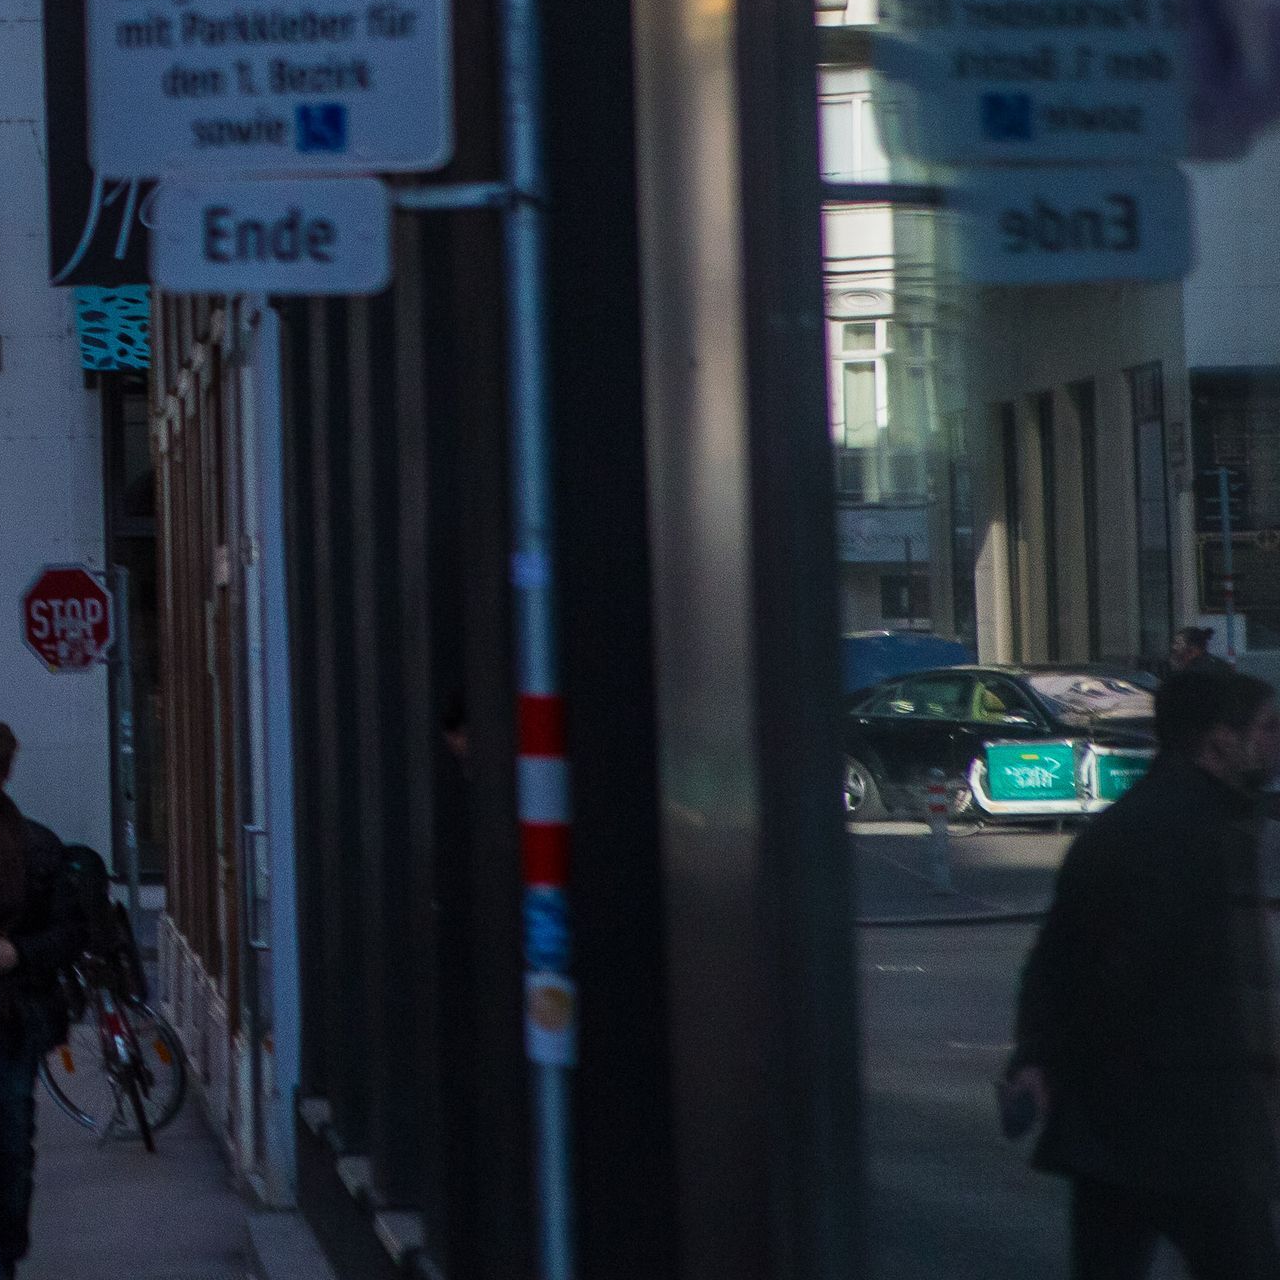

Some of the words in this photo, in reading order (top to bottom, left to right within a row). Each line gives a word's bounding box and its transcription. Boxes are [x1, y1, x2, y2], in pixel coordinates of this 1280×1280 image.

[116, 14, 173, 48] mit
[180, 9, 354, 45] Parkkleber
[364, 5, 415, 39] für
[162, 63, 224, 99] den
[268, 57, 372, 93] Bezirk
[191, 115, 285, 149] sowie
[201, 207, 337, 264] Ende
[30, 598, 103, 639] STOP
